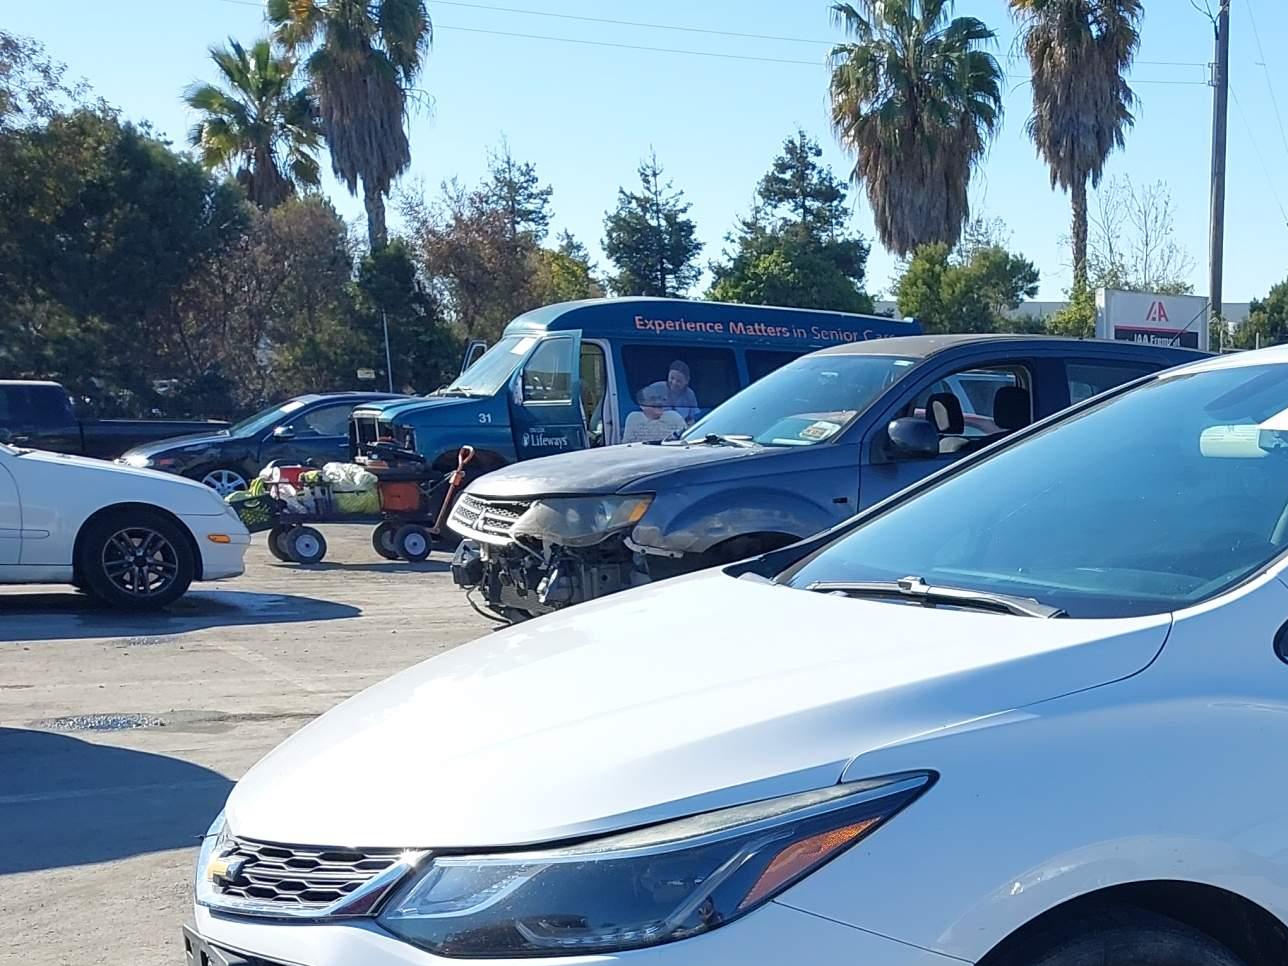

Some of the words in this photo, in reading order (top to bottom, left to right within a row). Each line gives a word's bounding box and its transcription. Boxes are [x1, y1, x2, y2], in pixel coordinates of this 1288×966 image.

[634, 315, 723, 335] Experience
[729, 321, 790, 337] Matters
[792, 325, 807, 339] in
[810, 326, 858, 342] Senior
[478, 412, 492, 424] 31
[530, 432, 568, 449] Lifeways
